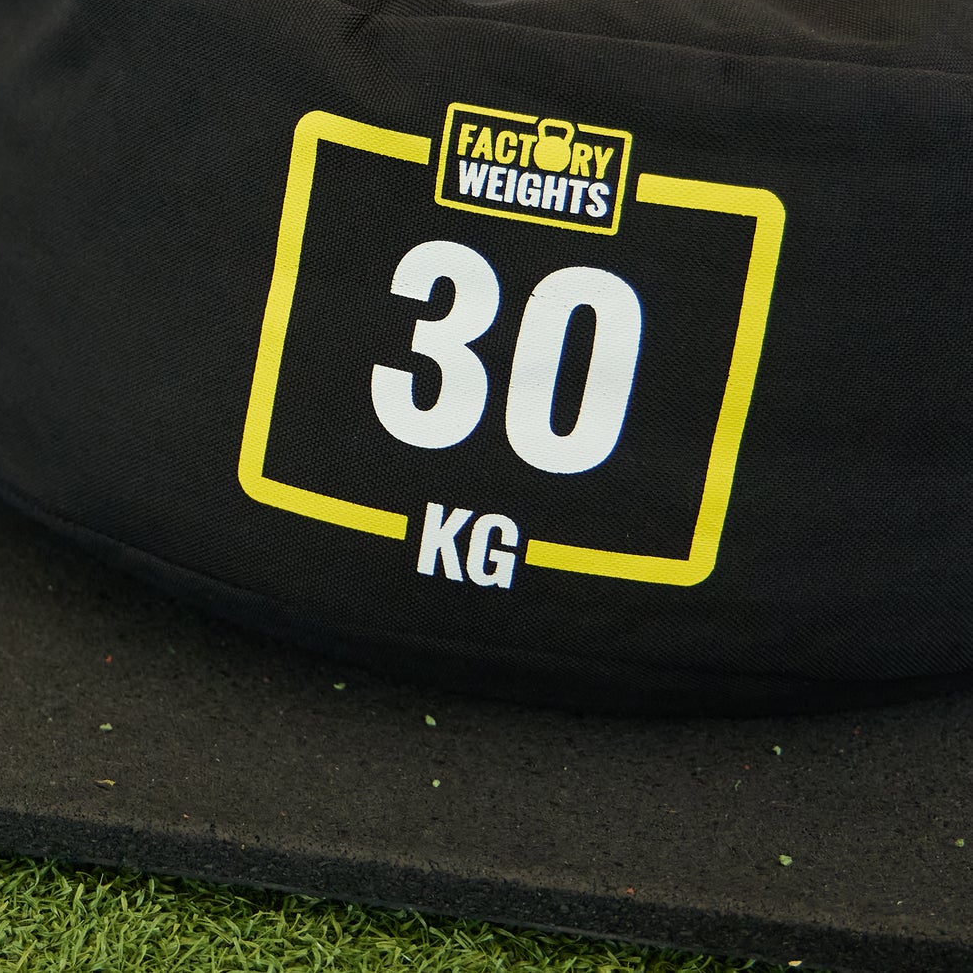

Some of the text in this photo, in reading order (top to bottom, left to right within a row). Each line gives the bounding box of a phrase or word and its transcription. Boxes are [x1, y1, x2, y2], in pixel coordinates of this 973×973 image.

[457, 118, 615, 180] FACTORY
[458, 159, 611, 218] WEIGHTS
[370, 240, 642, 475] 30
[416, 501, 519, 590] KG
